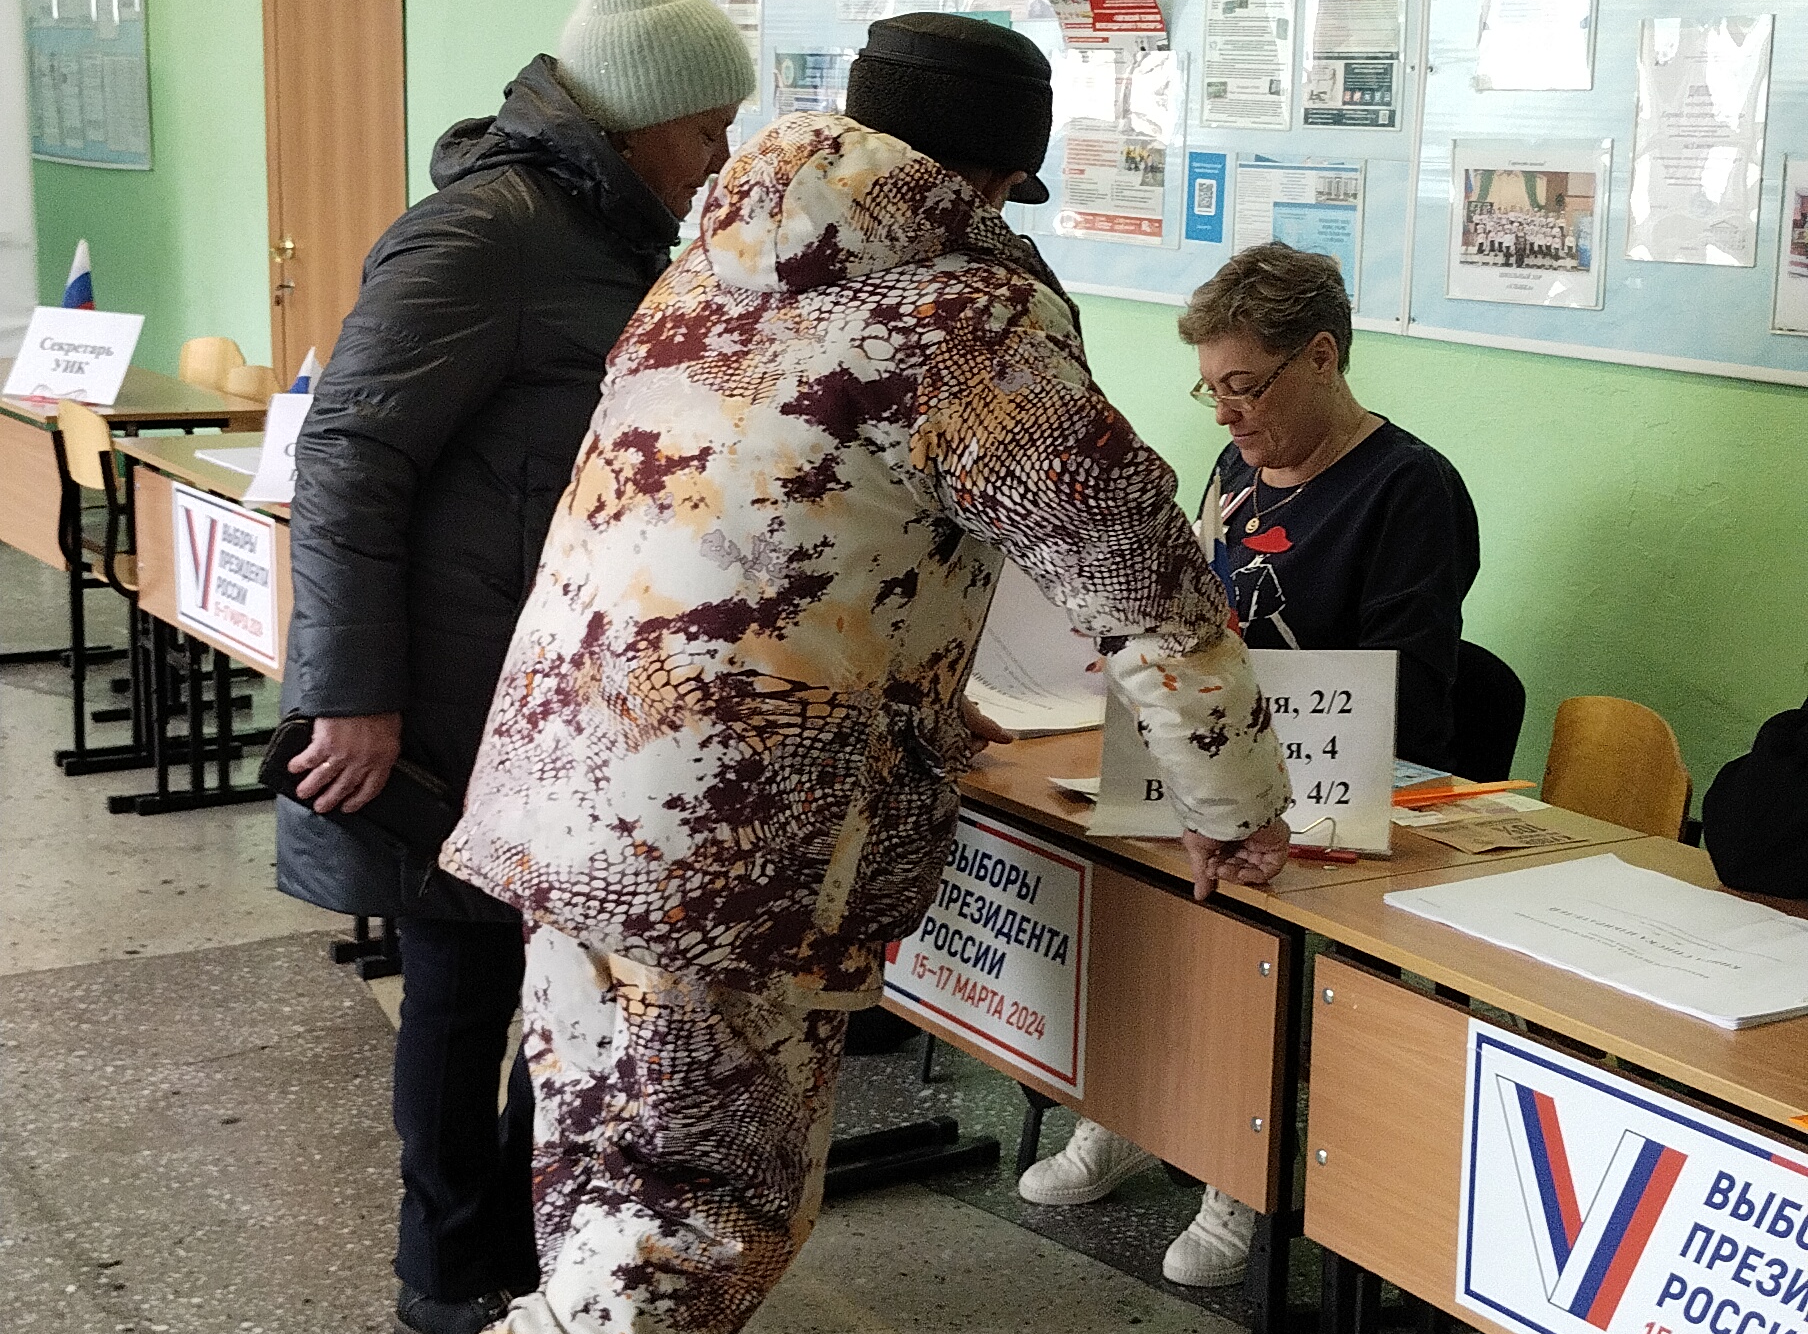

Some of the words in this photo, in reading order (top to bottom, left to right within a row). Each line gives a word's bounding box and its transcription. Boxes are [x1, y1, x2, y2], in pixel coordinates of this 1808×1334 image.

[39, 336, 115, 360] Секретарь
[51, 358, 90, 375] УИК
[1309, 688, 1353, 715] 2/2
[1321, 735, 1339, 760] 4
[1307, 780, 1351, 806] 4/2
[935, 879, 1070, 966] ПРЕЗИДЕНТА
[919, 915, 1007, 980] РОССИИ
[951, 972, 1006, 1021] МАРТА
[1005, 999, 1046, 1041] 2024
[1679, 1221, 1808, 1323] ПРЕЗИ
